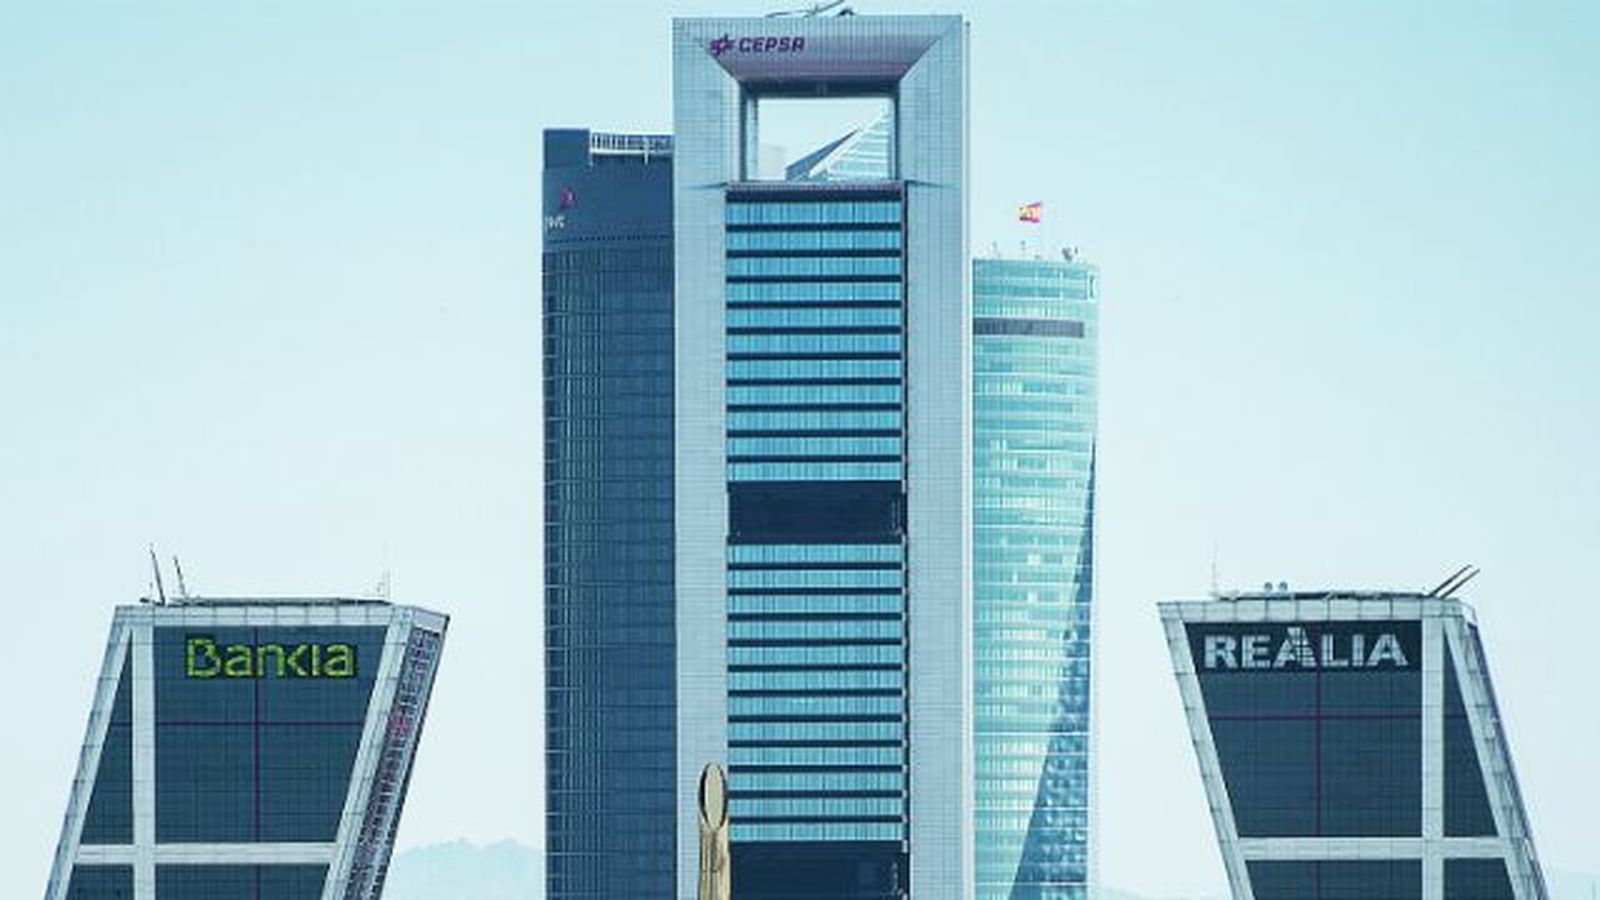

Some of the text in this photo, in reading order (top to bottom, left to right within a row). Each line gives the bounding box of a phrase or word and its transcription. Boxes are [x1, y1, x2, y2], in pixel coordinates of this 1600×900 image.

[738, 36, 806, 53] CEPSA
[186, 637, 356, 677] Bankia
[1203, 626, 1409, 670] REALIA
